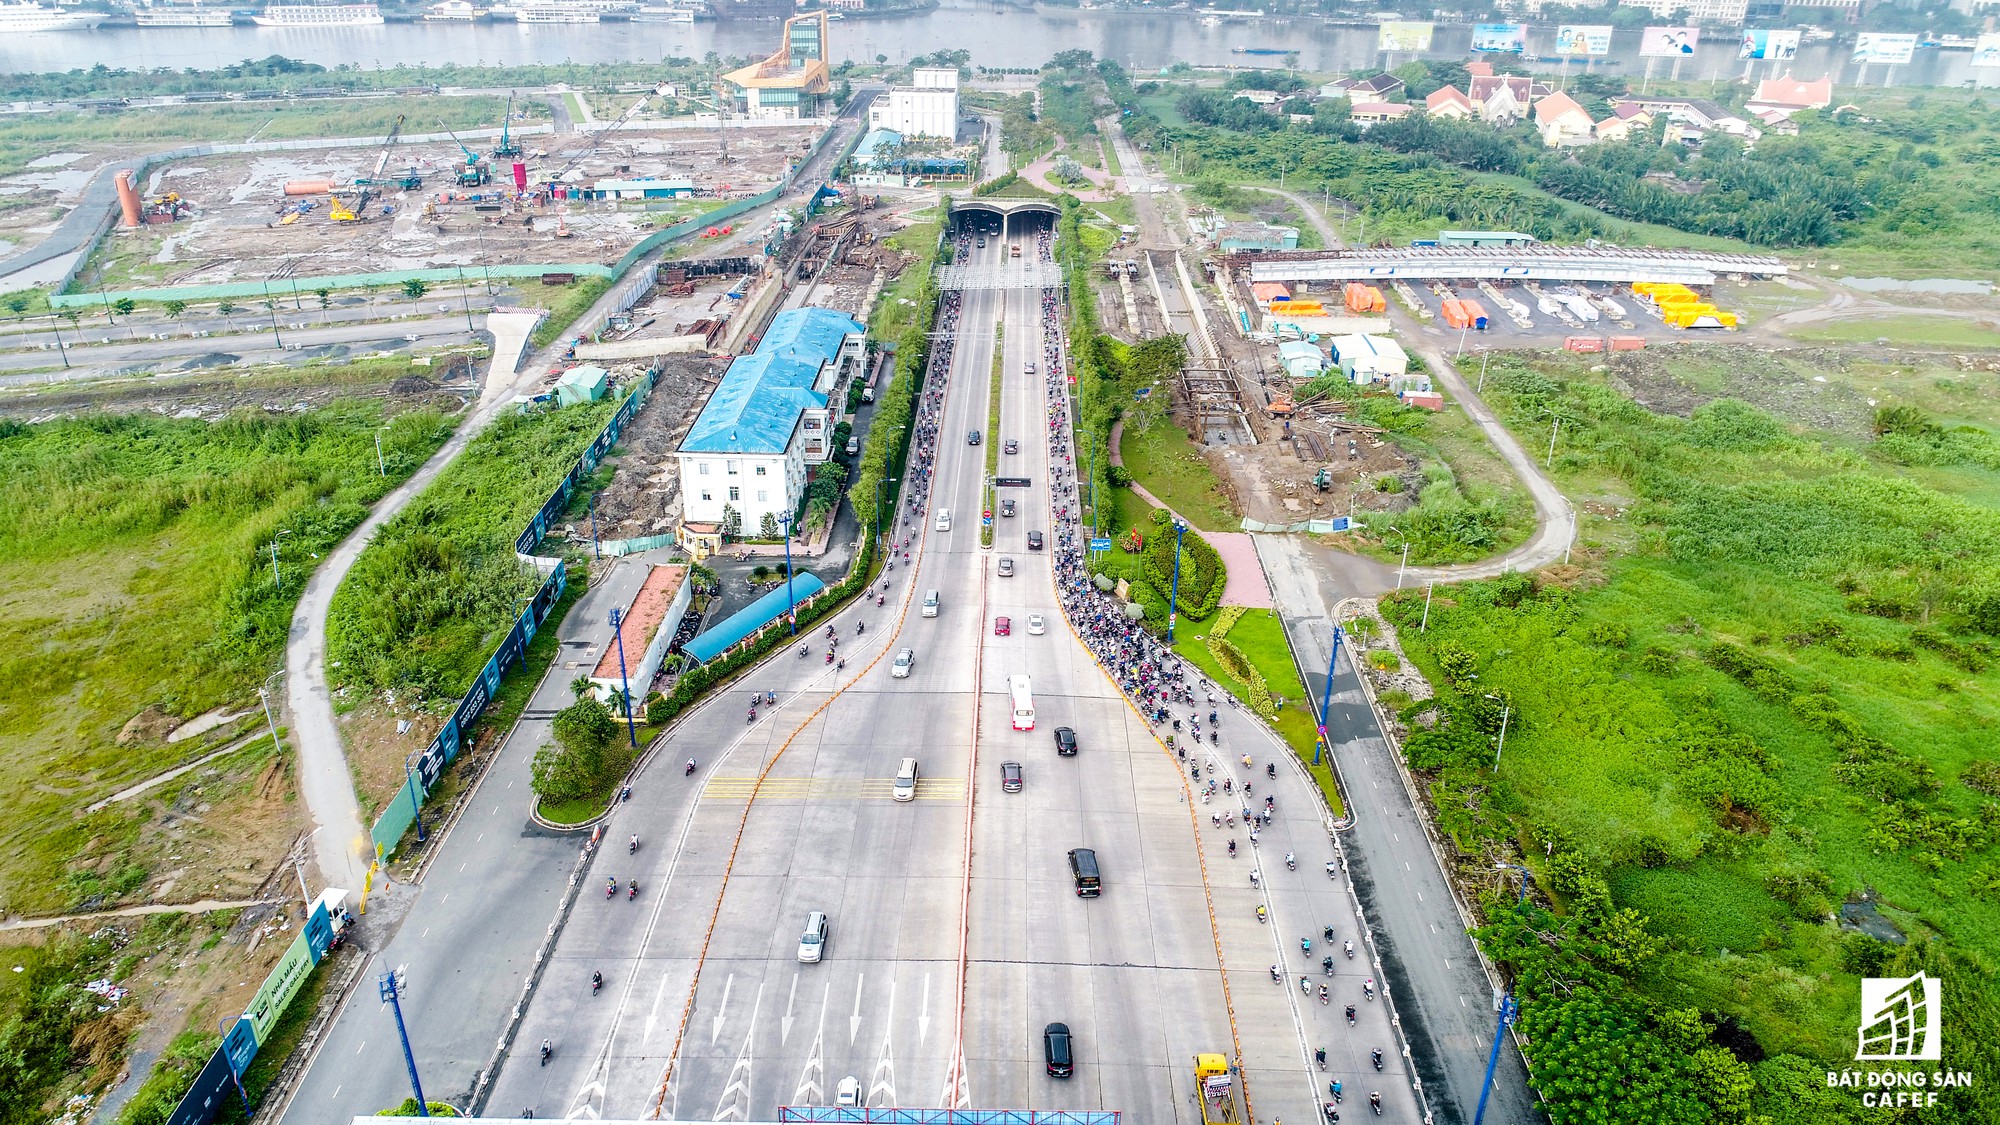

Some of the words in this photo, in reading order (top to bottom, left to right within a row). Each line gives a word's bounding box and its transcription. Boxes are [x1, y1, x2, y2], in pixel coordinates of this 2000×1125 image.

[271, 976, 285, 998] NHÀ
[274, 986, 290, 1010] SALES
[289, 957, 310, 988] GALLERY
